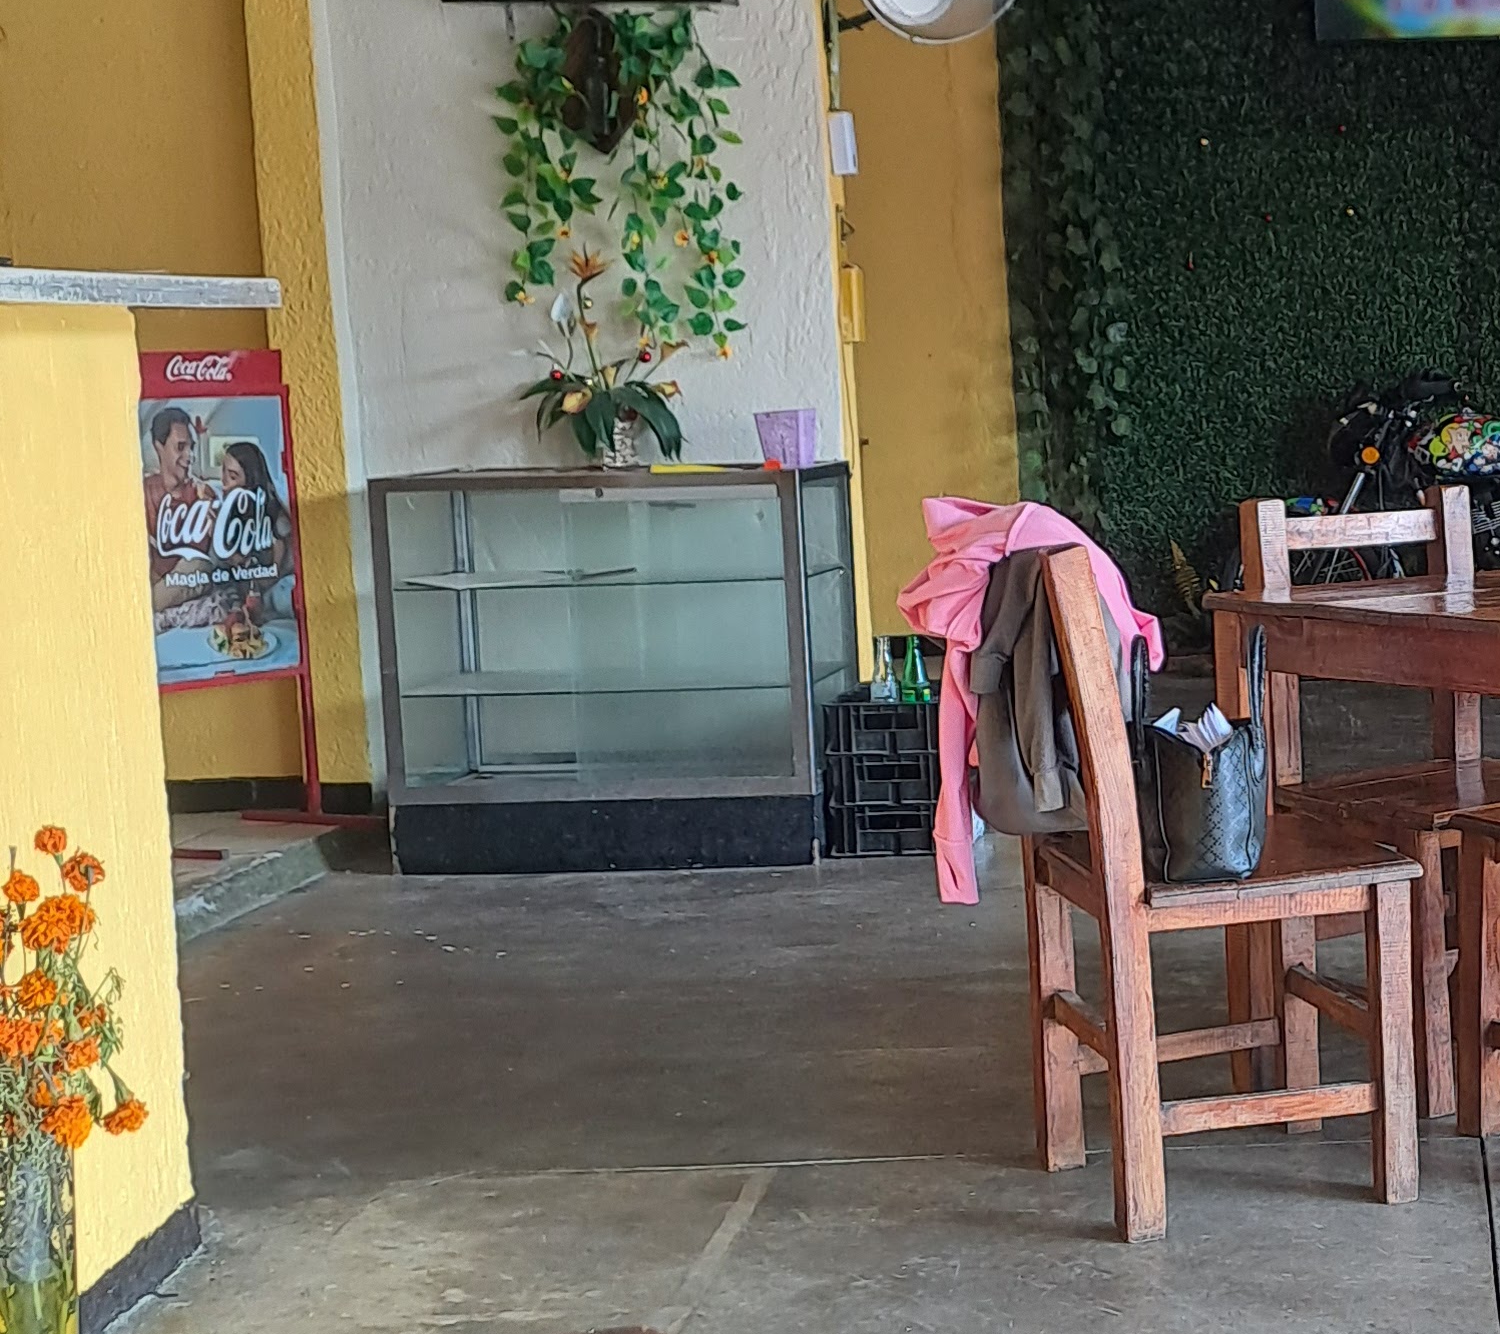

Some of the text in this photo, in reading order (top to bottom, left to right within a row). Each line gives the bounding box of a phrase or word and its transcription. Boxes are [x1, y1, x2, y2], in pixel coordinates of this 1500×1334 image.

[156, 486, 274, 561] Coca-Cola
[165, 563, 278, 587] Magia de Verdad
